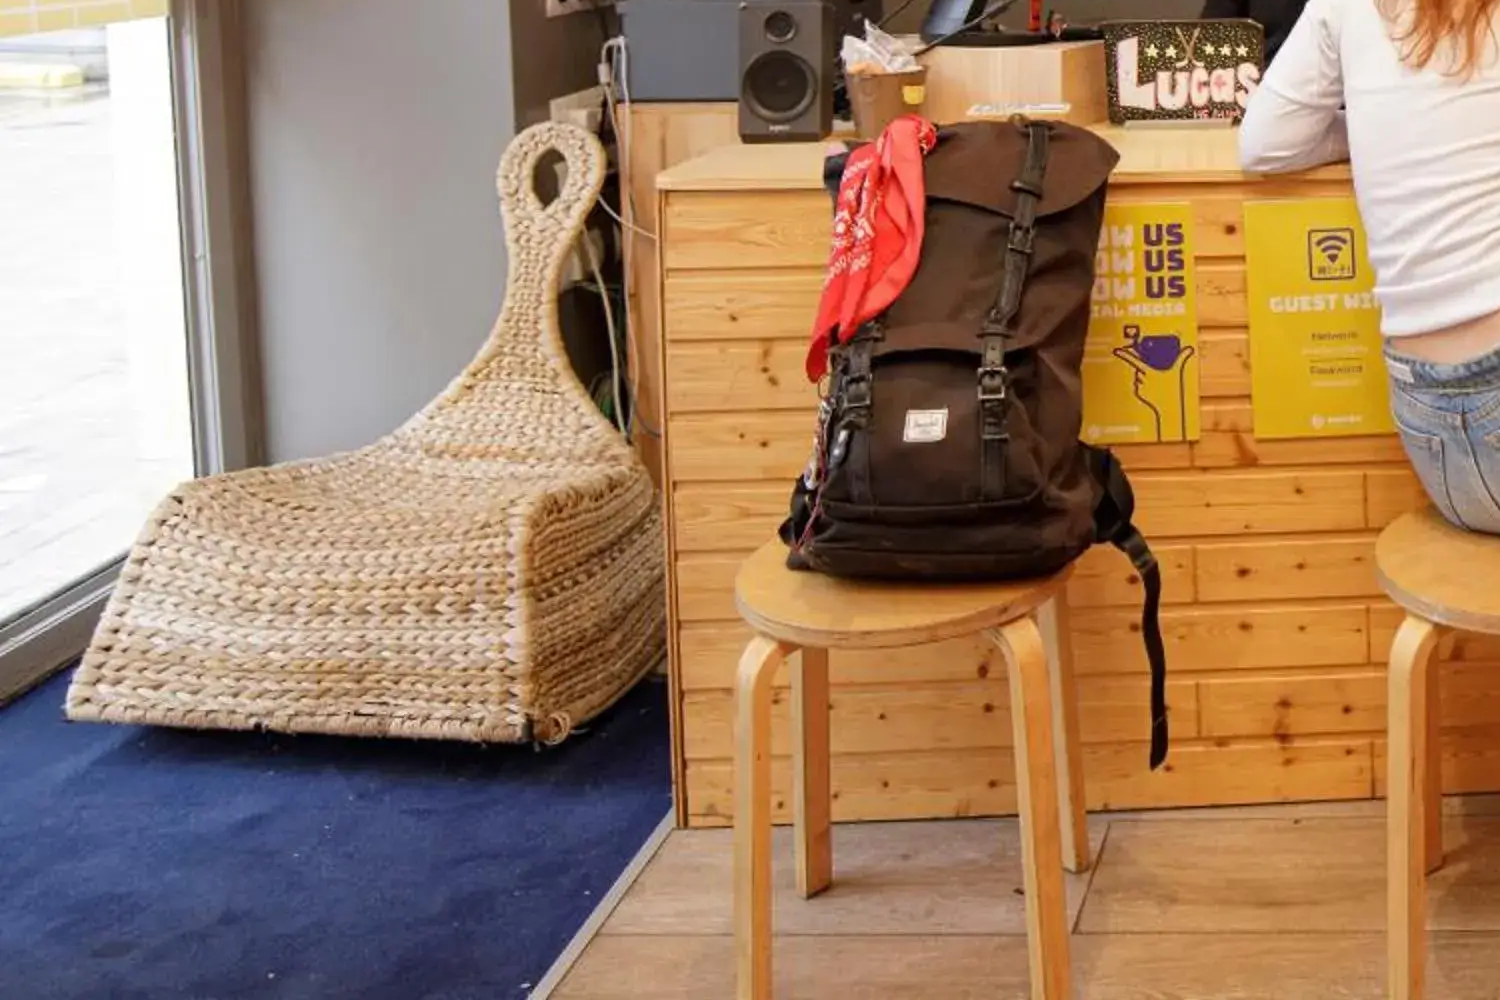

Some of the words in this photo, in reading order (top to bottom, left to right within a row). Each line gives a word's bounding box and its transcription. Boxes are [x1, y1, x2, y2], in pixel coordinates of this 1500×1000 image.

[1143, 223, 1184, 247] US
[1144, 249, 1185, 272] US
[1145, 275, 1186, 299] US
[1128, 302, 1185, 316] MEDIA
[1269, 292, 1338, 313] GUEST
